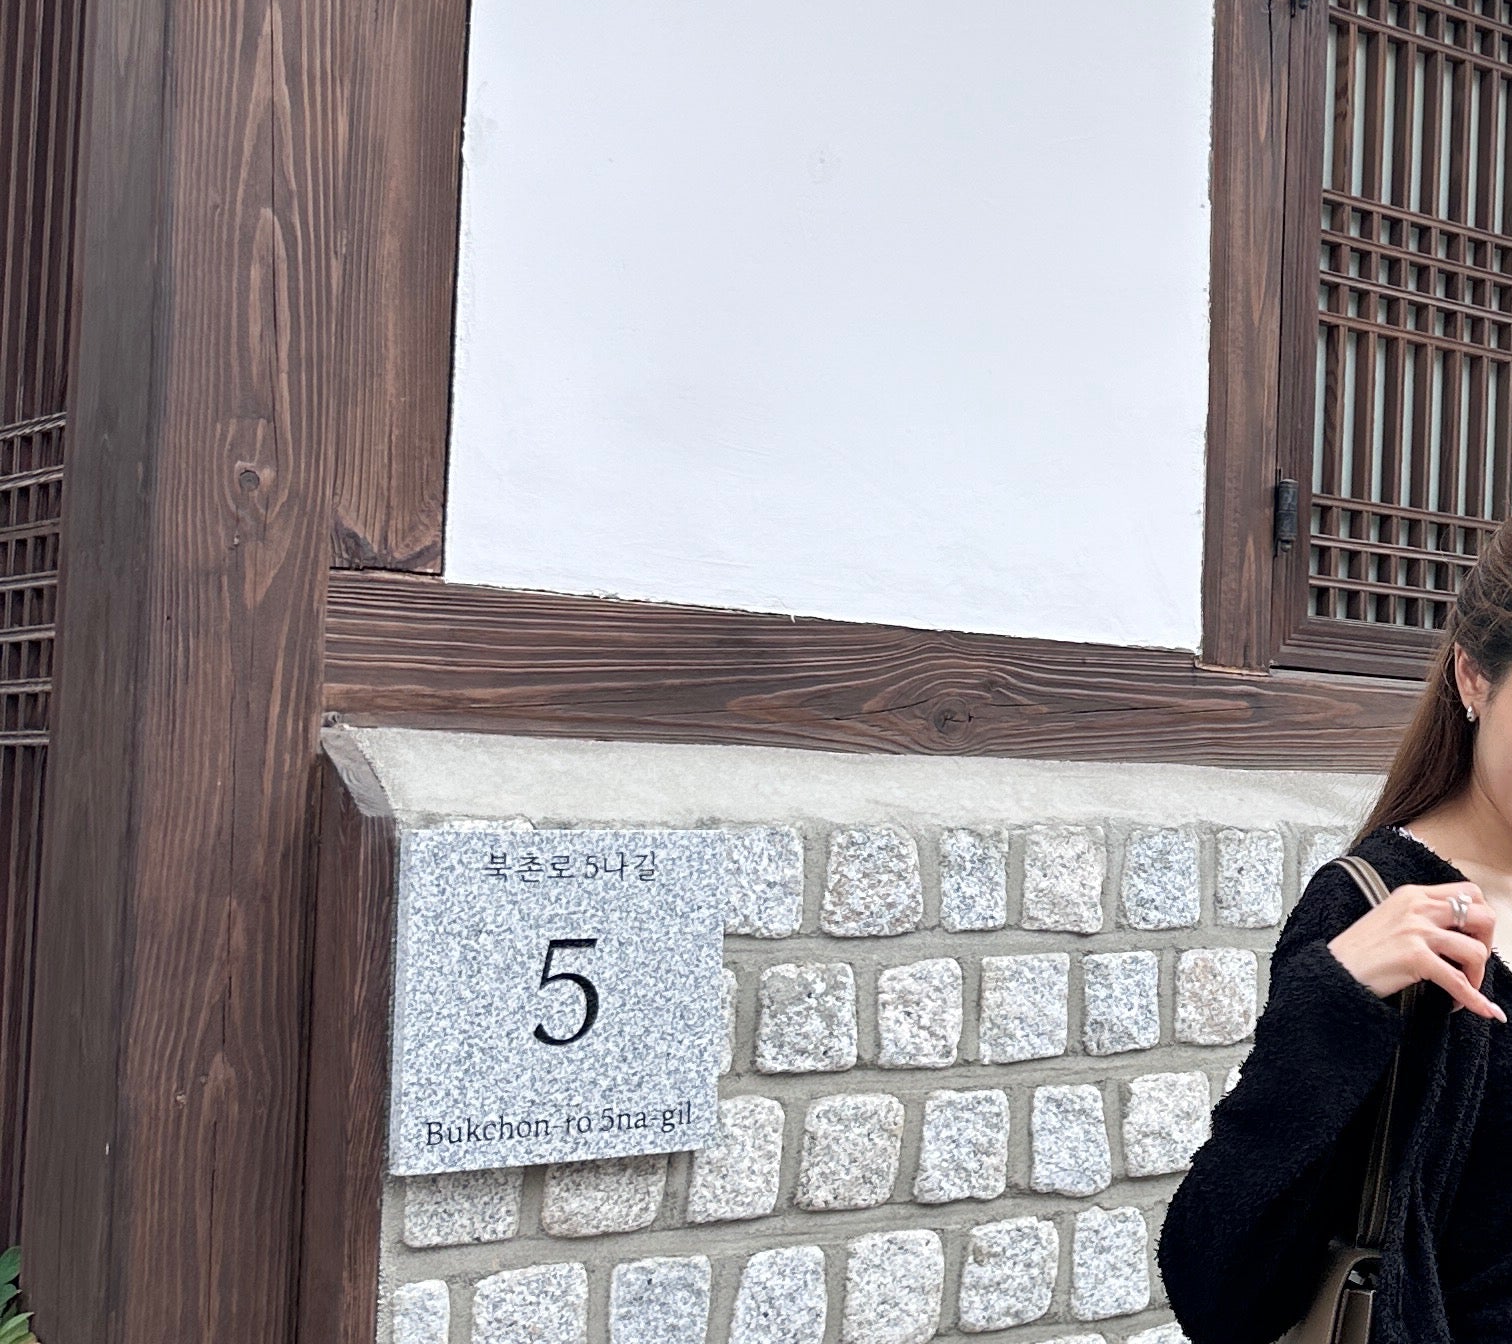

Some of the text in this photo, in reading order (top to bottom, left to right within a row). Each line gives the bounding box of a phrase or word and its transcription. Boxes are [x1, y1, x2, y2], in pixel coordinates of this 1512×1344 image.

[533, 938, 600, 1046] 5
[426, 1100, 692, 1146] Bukchon-ro 5na-gil
